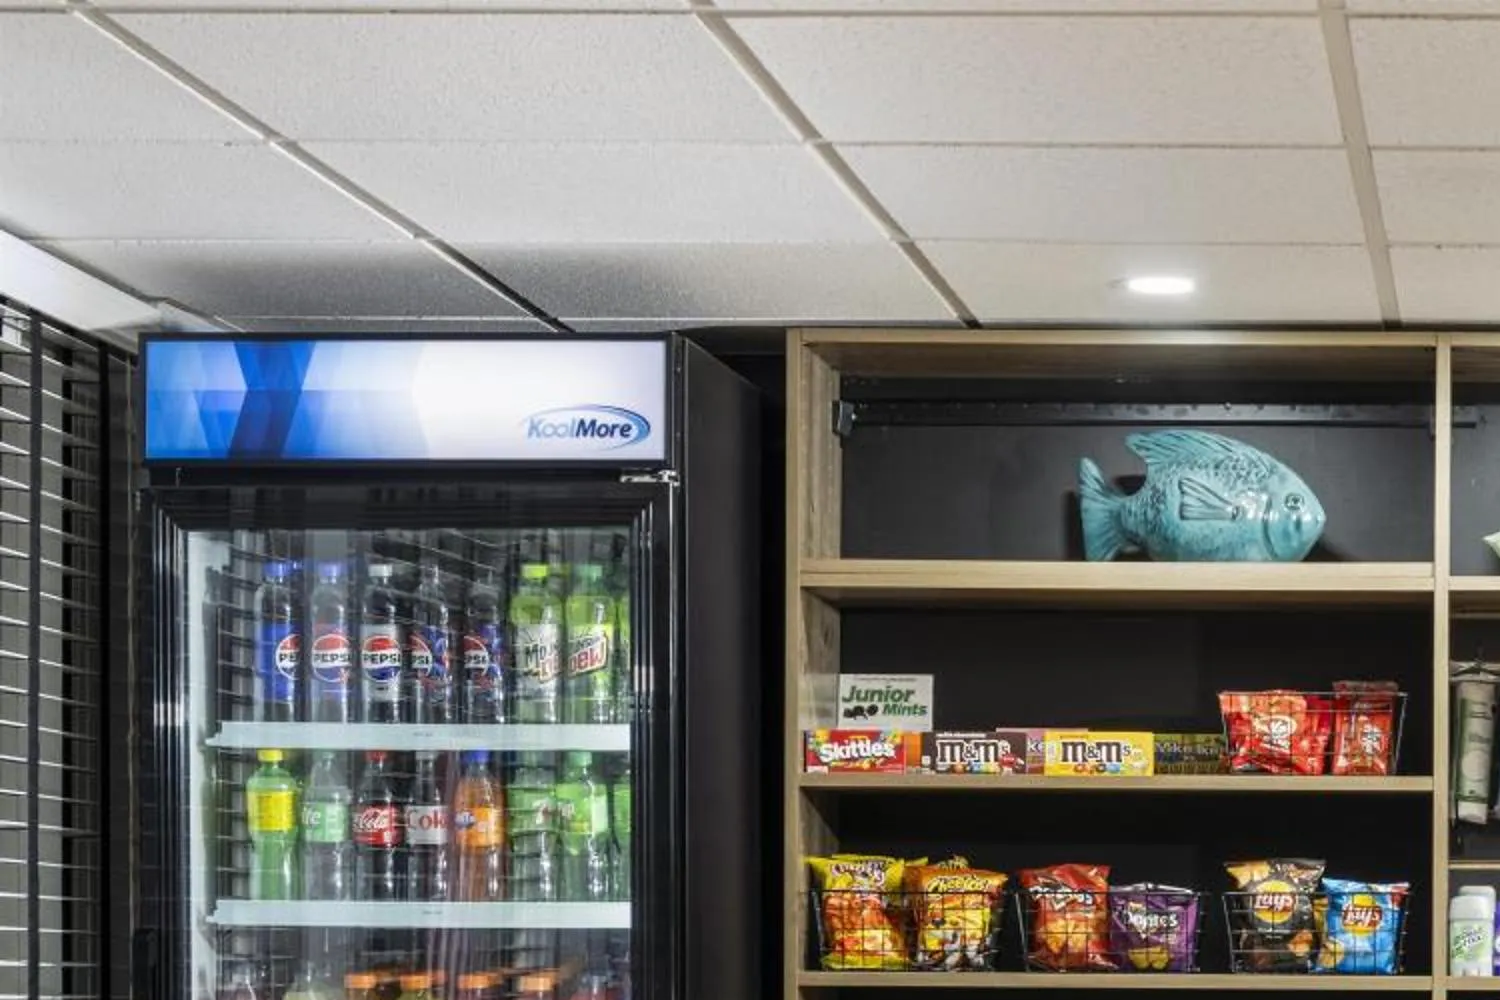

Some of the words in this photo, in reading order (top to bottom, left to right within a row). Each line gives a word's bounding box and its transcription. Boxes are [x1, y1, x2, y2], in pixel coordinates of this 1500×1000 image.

[527, 416, 633, 438] KoolMore
[842, 684, 915, 703] Junior
[882, 703, 928, 717] Mints
[818, 739, 897, 763] Skittles
